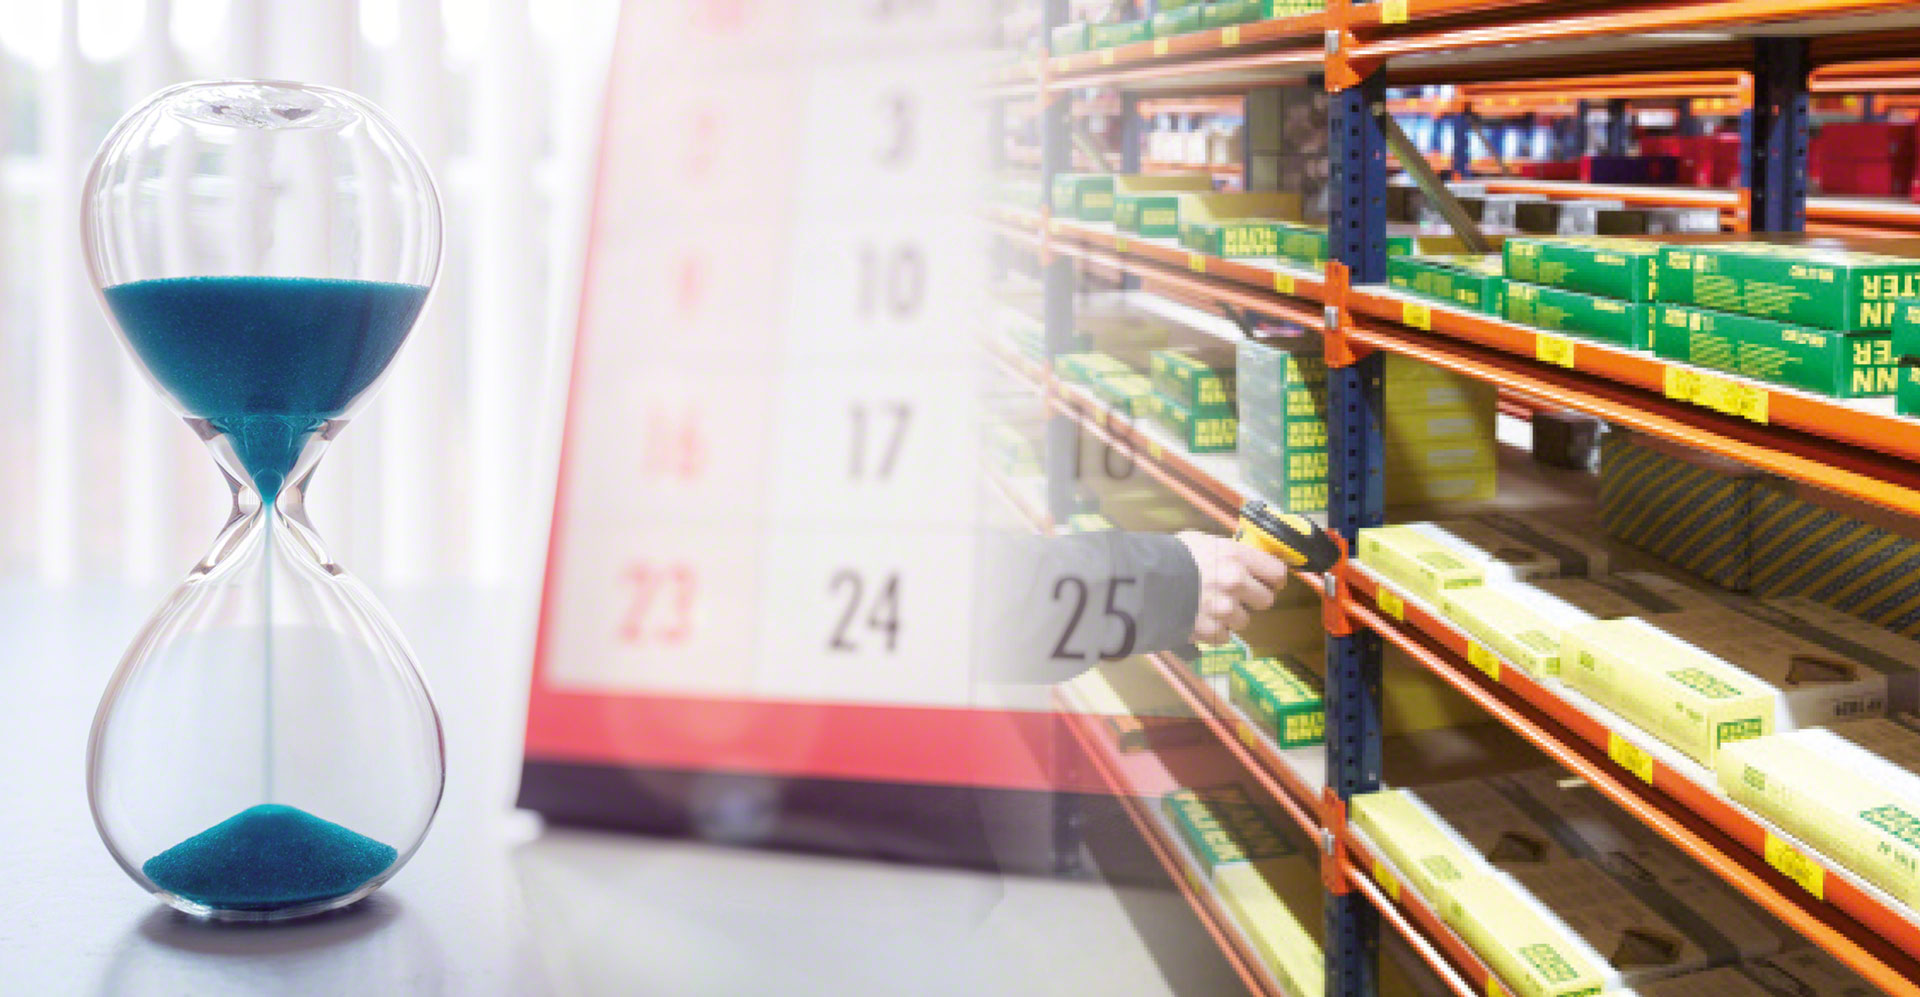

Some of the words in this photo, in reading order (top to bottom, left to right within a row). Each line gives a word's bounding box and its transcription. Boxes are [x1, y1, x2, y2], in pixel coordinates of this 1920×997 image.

[872, 88, 918, 170] 3
[856, 241, 927, 321] 10
[1853, 340, 1898, 365] ER
[847, 401, 914, 482] 17
[616, 560, 696, 648] 23
[826, 569, 902, 653] 24
[1050, 576, 1137, 662] 25
